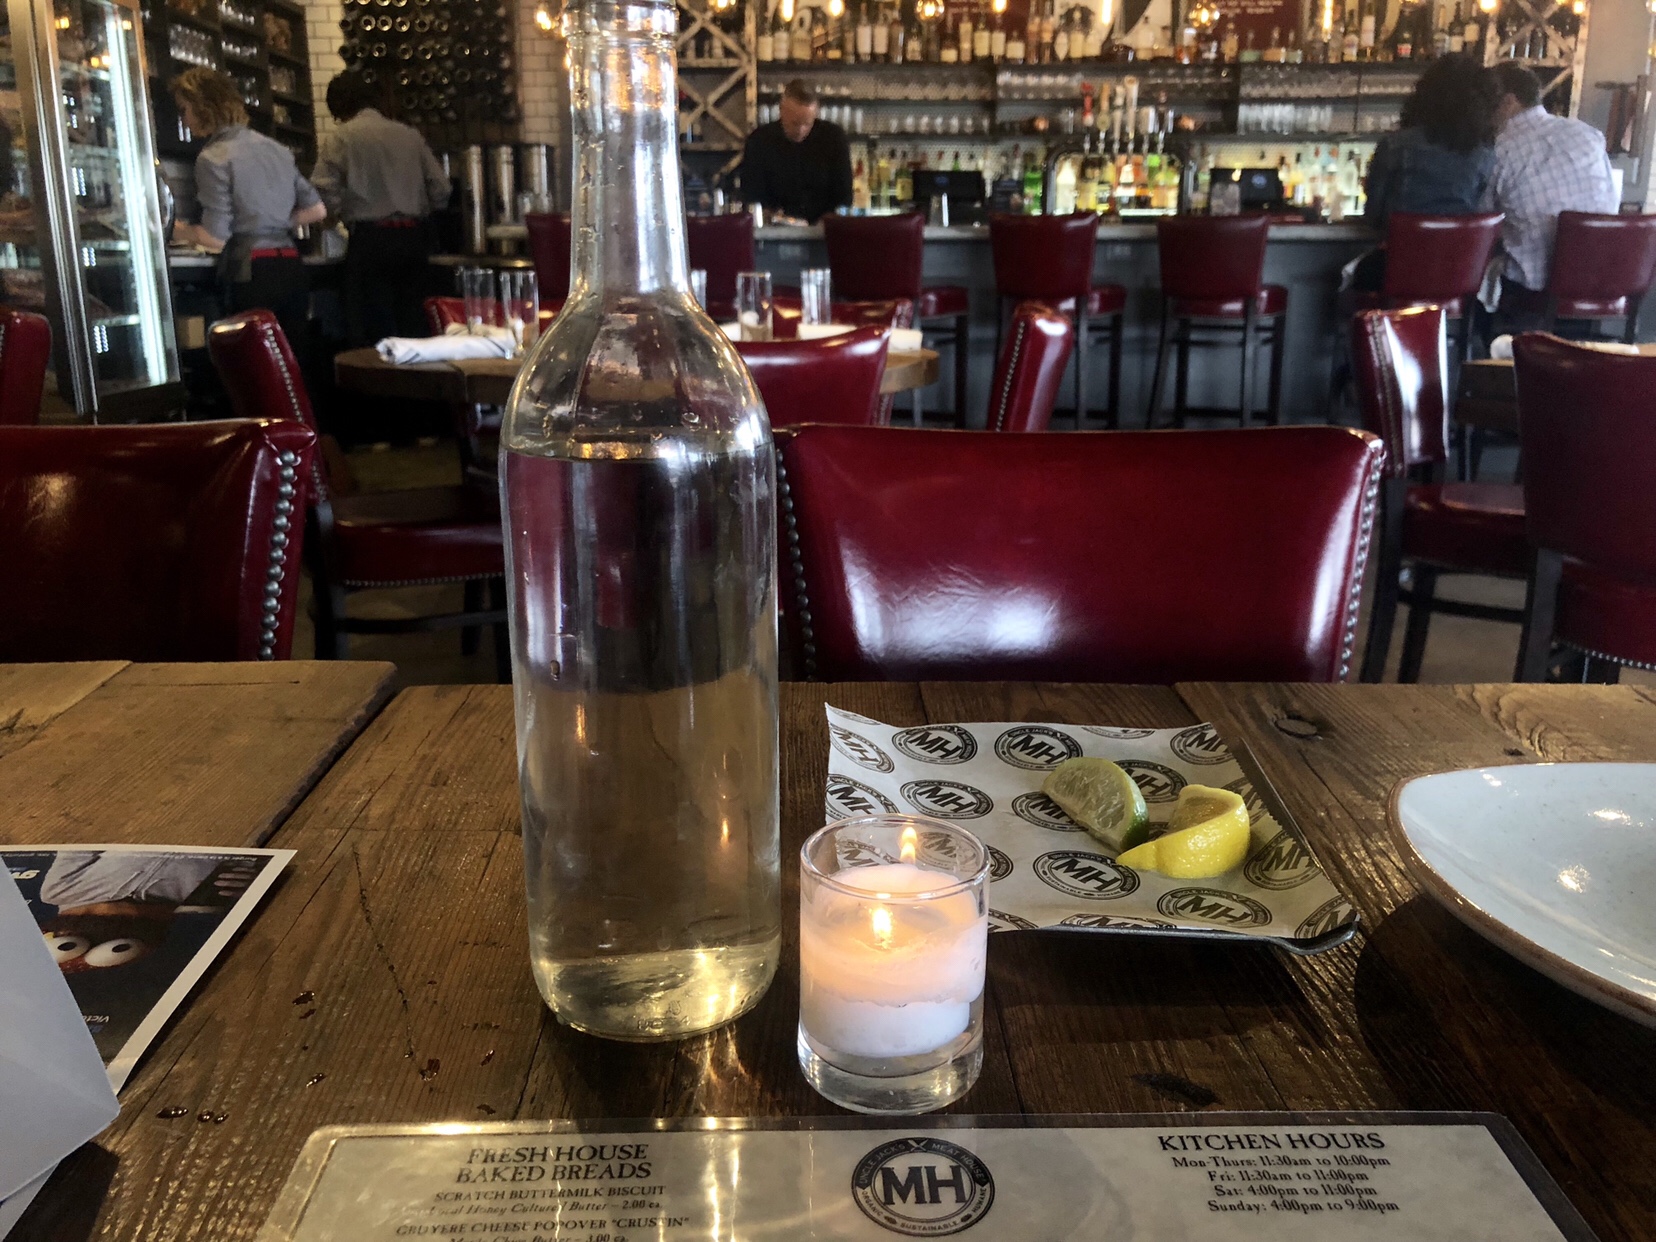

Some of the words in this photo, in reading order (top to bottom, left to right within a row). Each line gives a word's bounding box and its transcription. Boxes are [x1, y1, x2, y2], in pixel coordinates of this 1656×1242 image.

[831, 727, 880, 763] MH
[907, 731, 964, 759] MH
[1010, 734, 1069, 765] MH
[916, 785, 977, 814] MH
[1052, 858, 1121, 892] MH
[1177, 896, 1252, 923] MH
[467, 1145, 550, 1165] FRESH
[555, 1143, 649, 1161] HOUSE
[1158, 1133, 1281, 1151] KITCHEN
[1285, 1132, 1386, 1150] HOURS
[456, 1164, 547, 1184] BAKED
[551, 1162, 653, 1182] BREADS
[858, 1159, 876, 1184] UNCLE
[931, 1143, 961, 1158] MEAT
[960, 1154, 985, 1180] HOUSE
[1171, 1155, 1258, 1168] Mon-Thurs:
[1259, 1154, 1312, 1167] 11:30am
[1316, 1156, 1332, 1167] to
[1333, 1153, 1392, 1169] 10:00pm
[881, 1165, 966, 1205] MH
[1206, 1170, 1237, 1182] Fri:
[1239, 1169, 1293, 1182] 11:30am
[1296, 1171, 1312, 1181] to
[1313, 1168, 1370, 1184] 11:00pm
[434, 1189, 507, 1202] SCRATCH
[508, 1186, 604, 1200] BUTTERMILK
[607, 1184, 667, 1197] BISCUIT
[861, 1190, 884, 1217] ORGANIC
[1214, 1184, 1244, 1197] Sat:
[1247, 1183, 1300, 1199] 4:00pm
[1303, 1185, 1319, 1196] to
[1321, 1183, 1378, 1199] 11:00pm
[466, 1203, 508, 1216] Honey
[569, 1201, 609, 1212] Butter
[622, 1199, 645, 1211] 2.00
[1207, 1200, 1268, 1215] Sunday:
[1270, 1198, 1324, 1214] 4:00pm
[1327, 1201, 1344, 1212] to
[1345, 1198, 1401, 1214] 9:00pm
